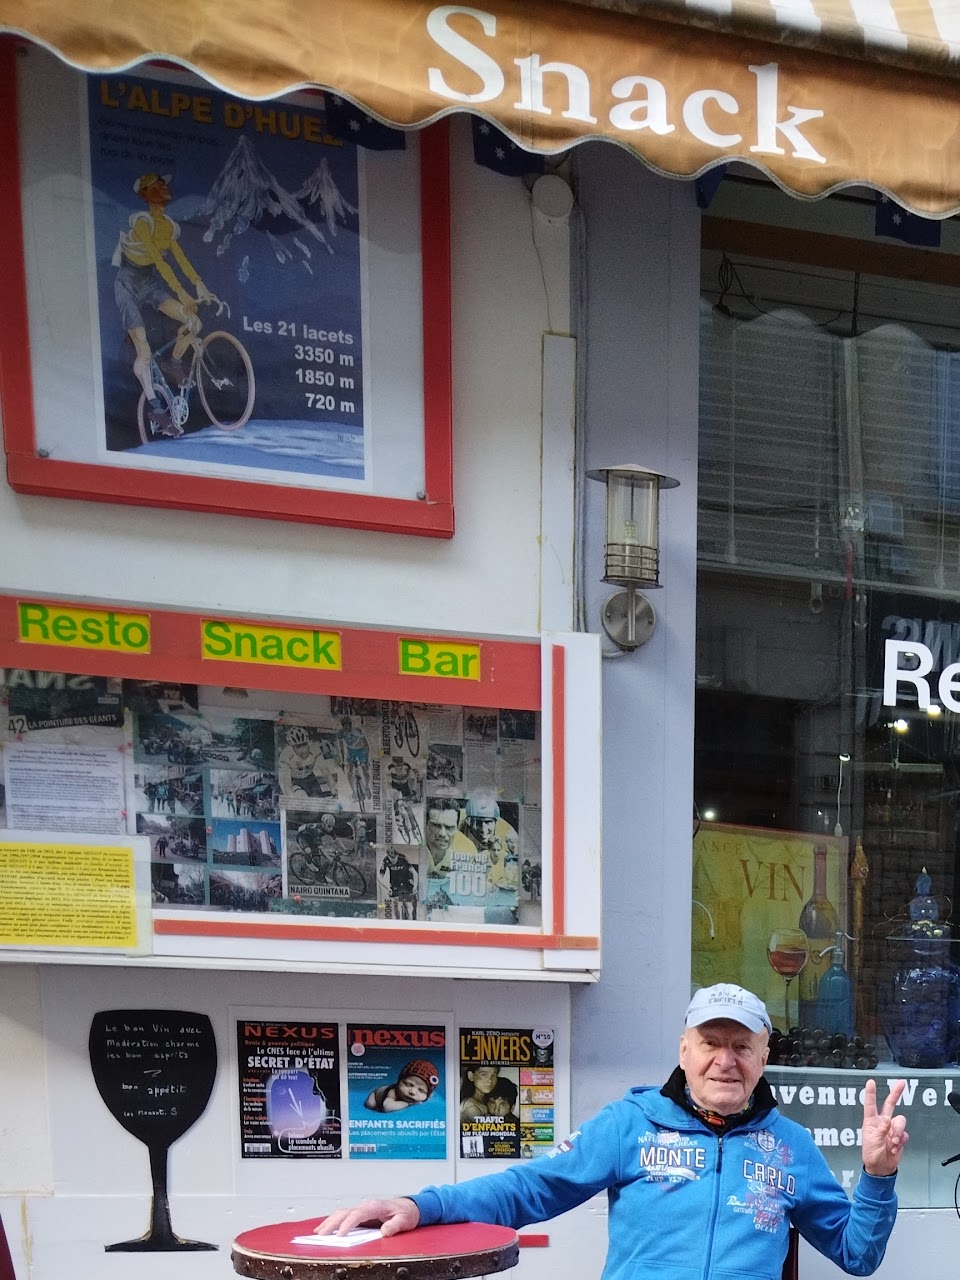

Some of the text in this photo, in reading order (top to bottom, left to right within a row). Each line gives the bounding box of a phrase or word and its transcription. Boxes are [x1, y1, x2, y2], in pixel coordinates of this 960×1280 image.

[426, 5, 826, 163] Snack
[101, 80, 213, 124] L'ALPE
[243, 316, 354, 345] Les 21 lacets
[294, 345, 354, 367] 3350 m
[295, 368, 354, 389] 1850 m
[305, 393, 355, 413] 720 m
[20, 603, 477, 678] Resto Snack Bar
[8, 718, 27, 734] 42
[28, 721, 38, 729] LA
[39, 719, 72, 728] POINTURE
[74, 716, 88, 724] DES
[381, 724, 392, 755] ALBERTO
[372, 759, 381, 780] PINOT
[702, 840, 743, 855] ANCE
[450, 860, 490, 873] France
[450, 874, 486, 898] 100
[739, 859, 807, 902] VIN
[290, 886, 349, 897] NAIRO QUINTANA
[124, 1023, 145, 1032] bon
[152, 1023, 170, 1033] Vin
[244, 1025, 335, 1039] NEXUS
[353, 1028, 446, 1047] nexus
[257, 1047, 265, 1055] Le
[266, 1047, 284, 1056] CNES
[286, 1047, 300, 1056] face
[308, 1047, 335, 1057] l'ultime
[247, 1056, 290, 1068] SECRET
[295, 1055, 335, 1070] D'ÉTAT
[534, 1092, 554, 1100] JACK
[349, 1119, 394, 1129] ENFANTS
[396, 1118, 446, 1129] SACRIFIÉS
[462, 1123, 516, 1132] D'ENFANTS
[474, 1116, 505, 1124] TRAFIC
[640, 1146, 706, 1169] MONTE
[743, 1158, 796, 1196] CARLO
